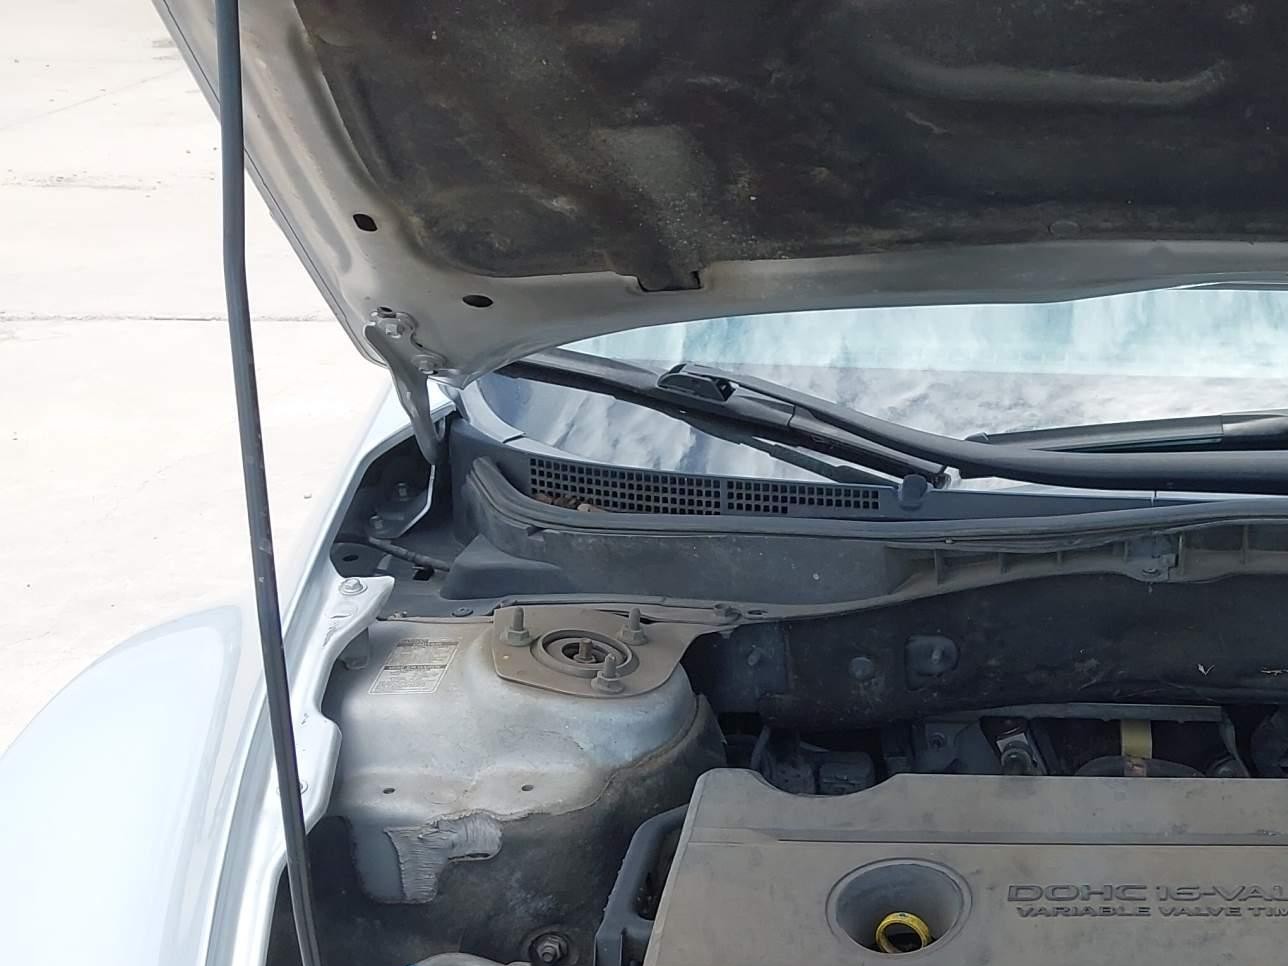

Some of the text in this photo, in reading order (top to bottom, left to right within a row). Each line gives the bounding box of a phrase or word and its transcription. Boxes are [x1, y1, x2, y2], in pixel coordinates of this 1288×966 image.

[1008, 884, 1148, 901] DOHC
[1016, 906, 1151, 918] VARIABLE
[1158, 906, 1241, 917] VALVE
